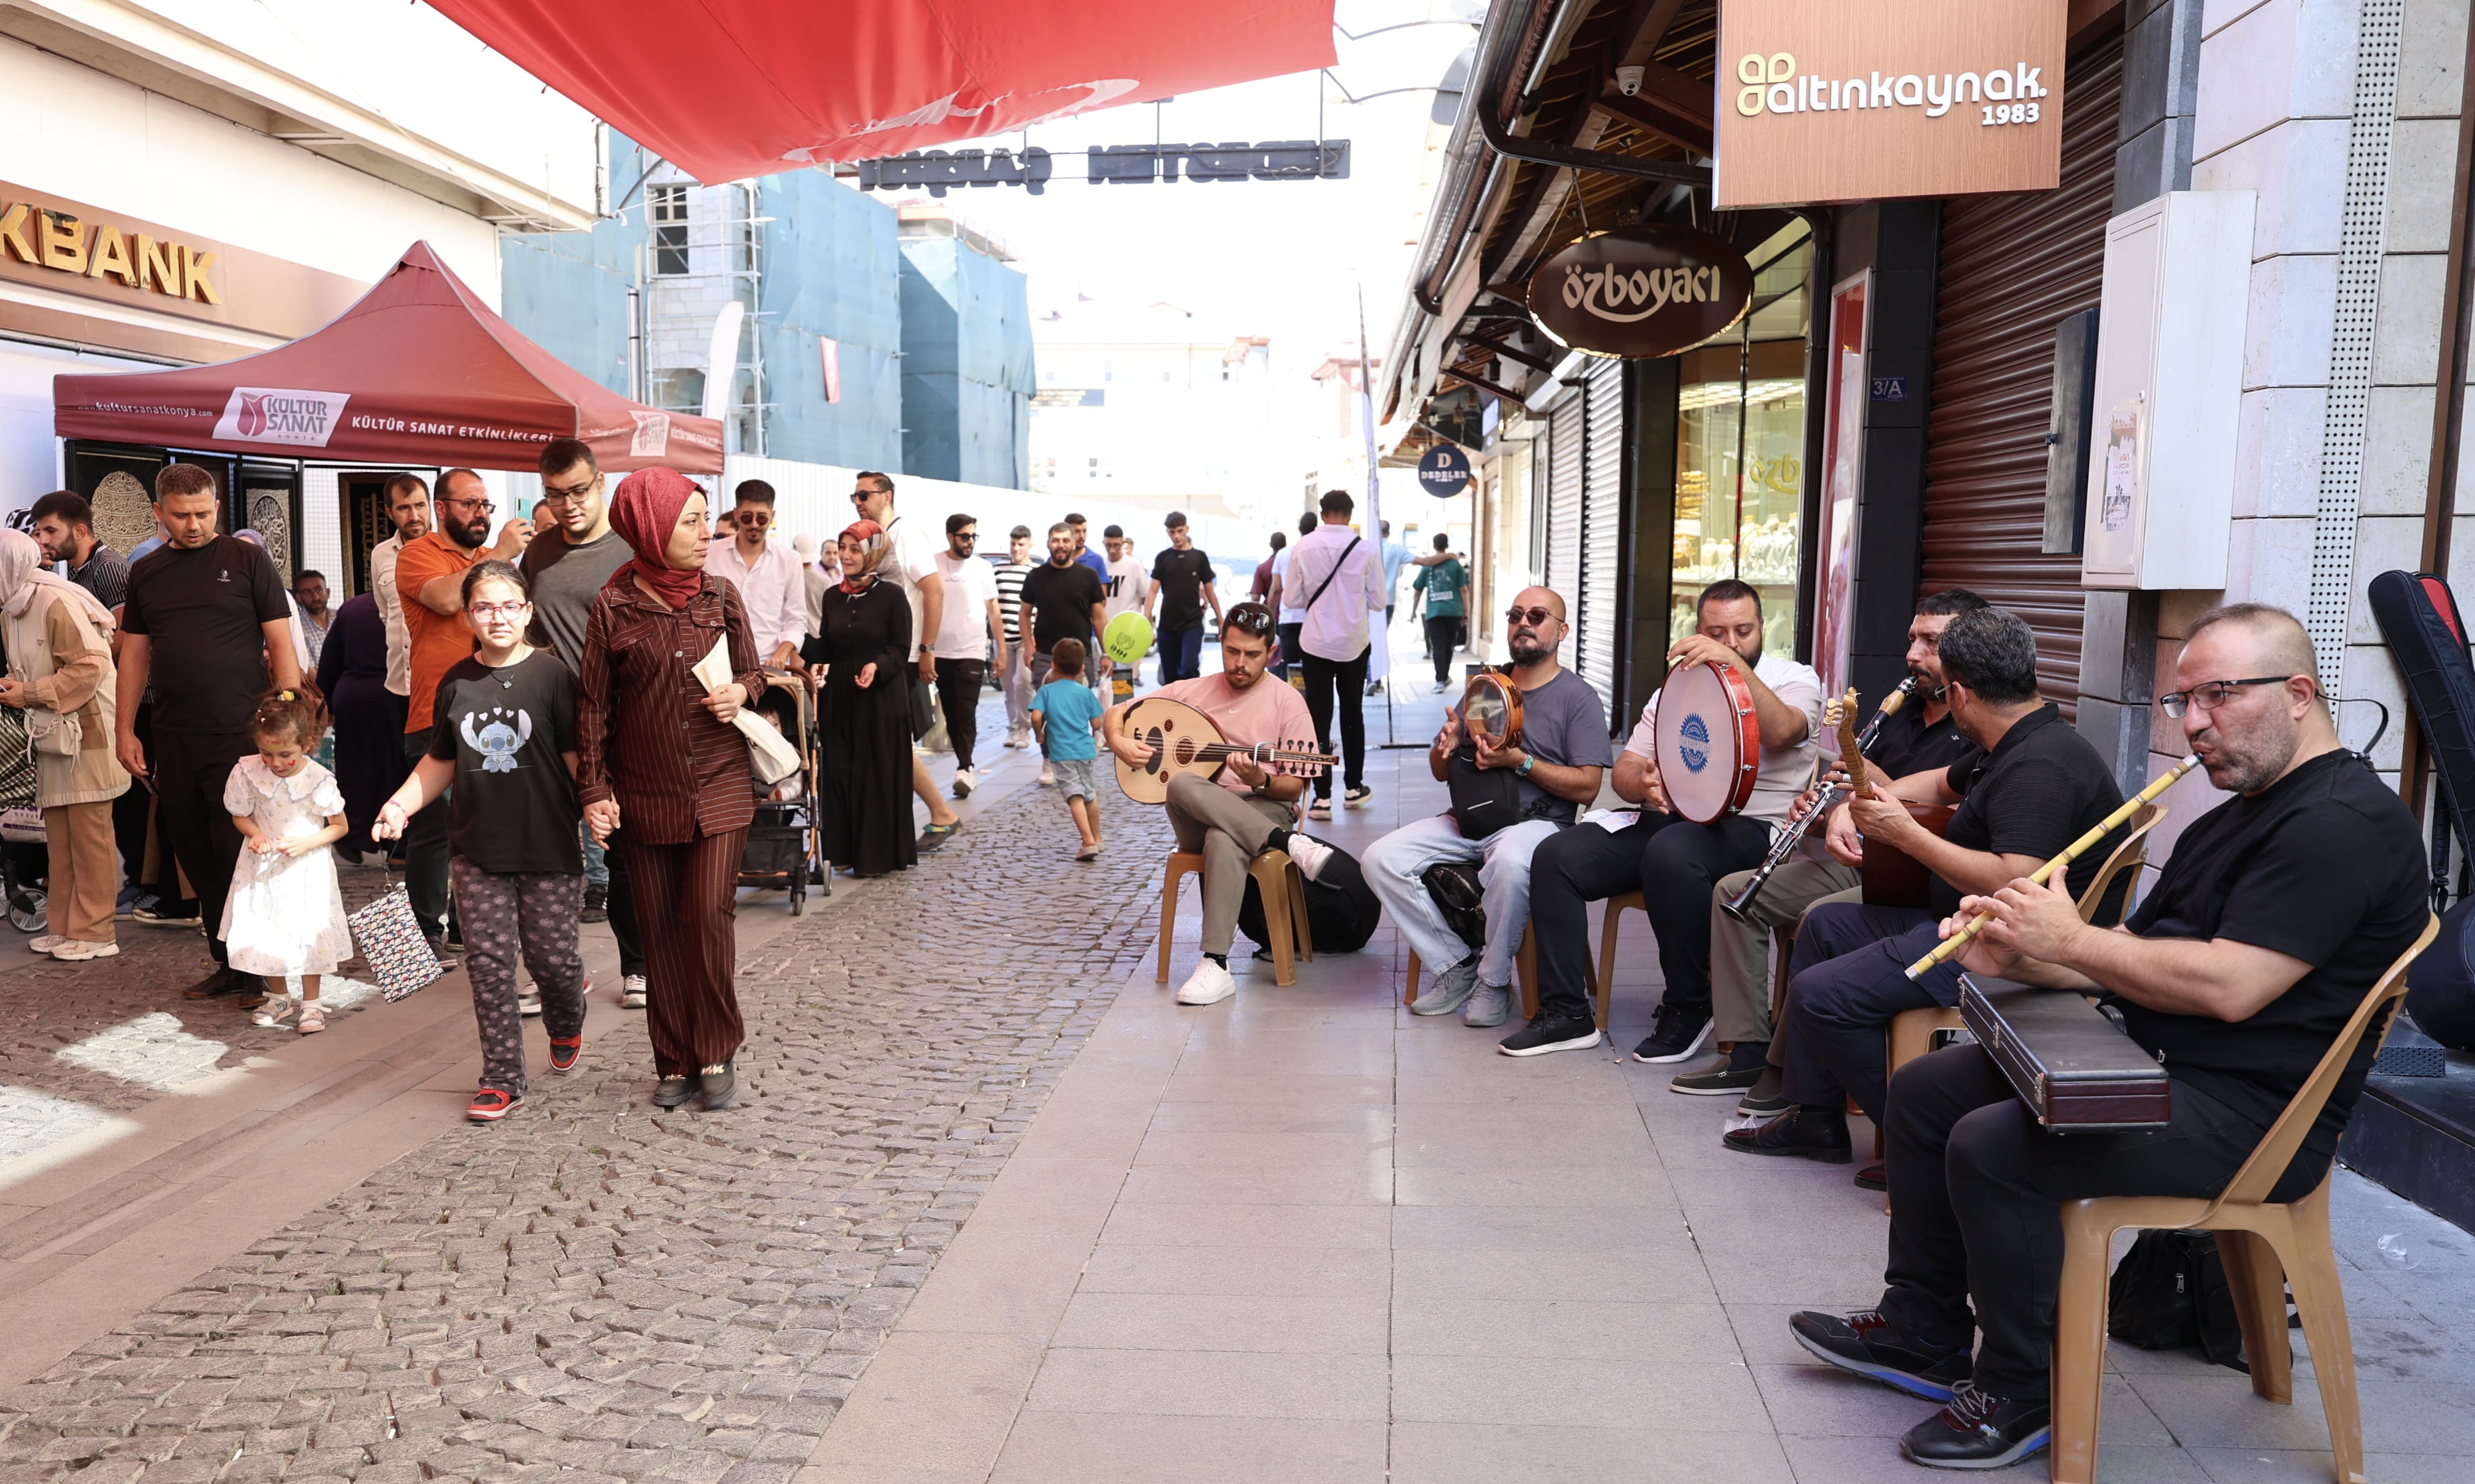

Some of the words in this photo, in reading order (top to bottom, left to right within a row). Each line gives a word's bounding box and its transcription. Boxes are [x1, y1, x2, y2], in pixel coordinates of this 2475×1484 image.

[1981, 102, 2040, 126] 1983
[1562, 262, 1720, 322] özboyacı
[1873, 380, 1902, 395] 3/A
[267, 398, 327, 417] KÜLTÜR
[267, 413, 327, 434] SANAT
[352, 415, 405, 432] KÜLTÜR
[410, 421, 454, 436] SANAT
[459, 426, 553, 443] ETKİNLİKLERİ
[1437, 453, 1452, 468] D
[1421, 471, 1467, 479] DEDELER
